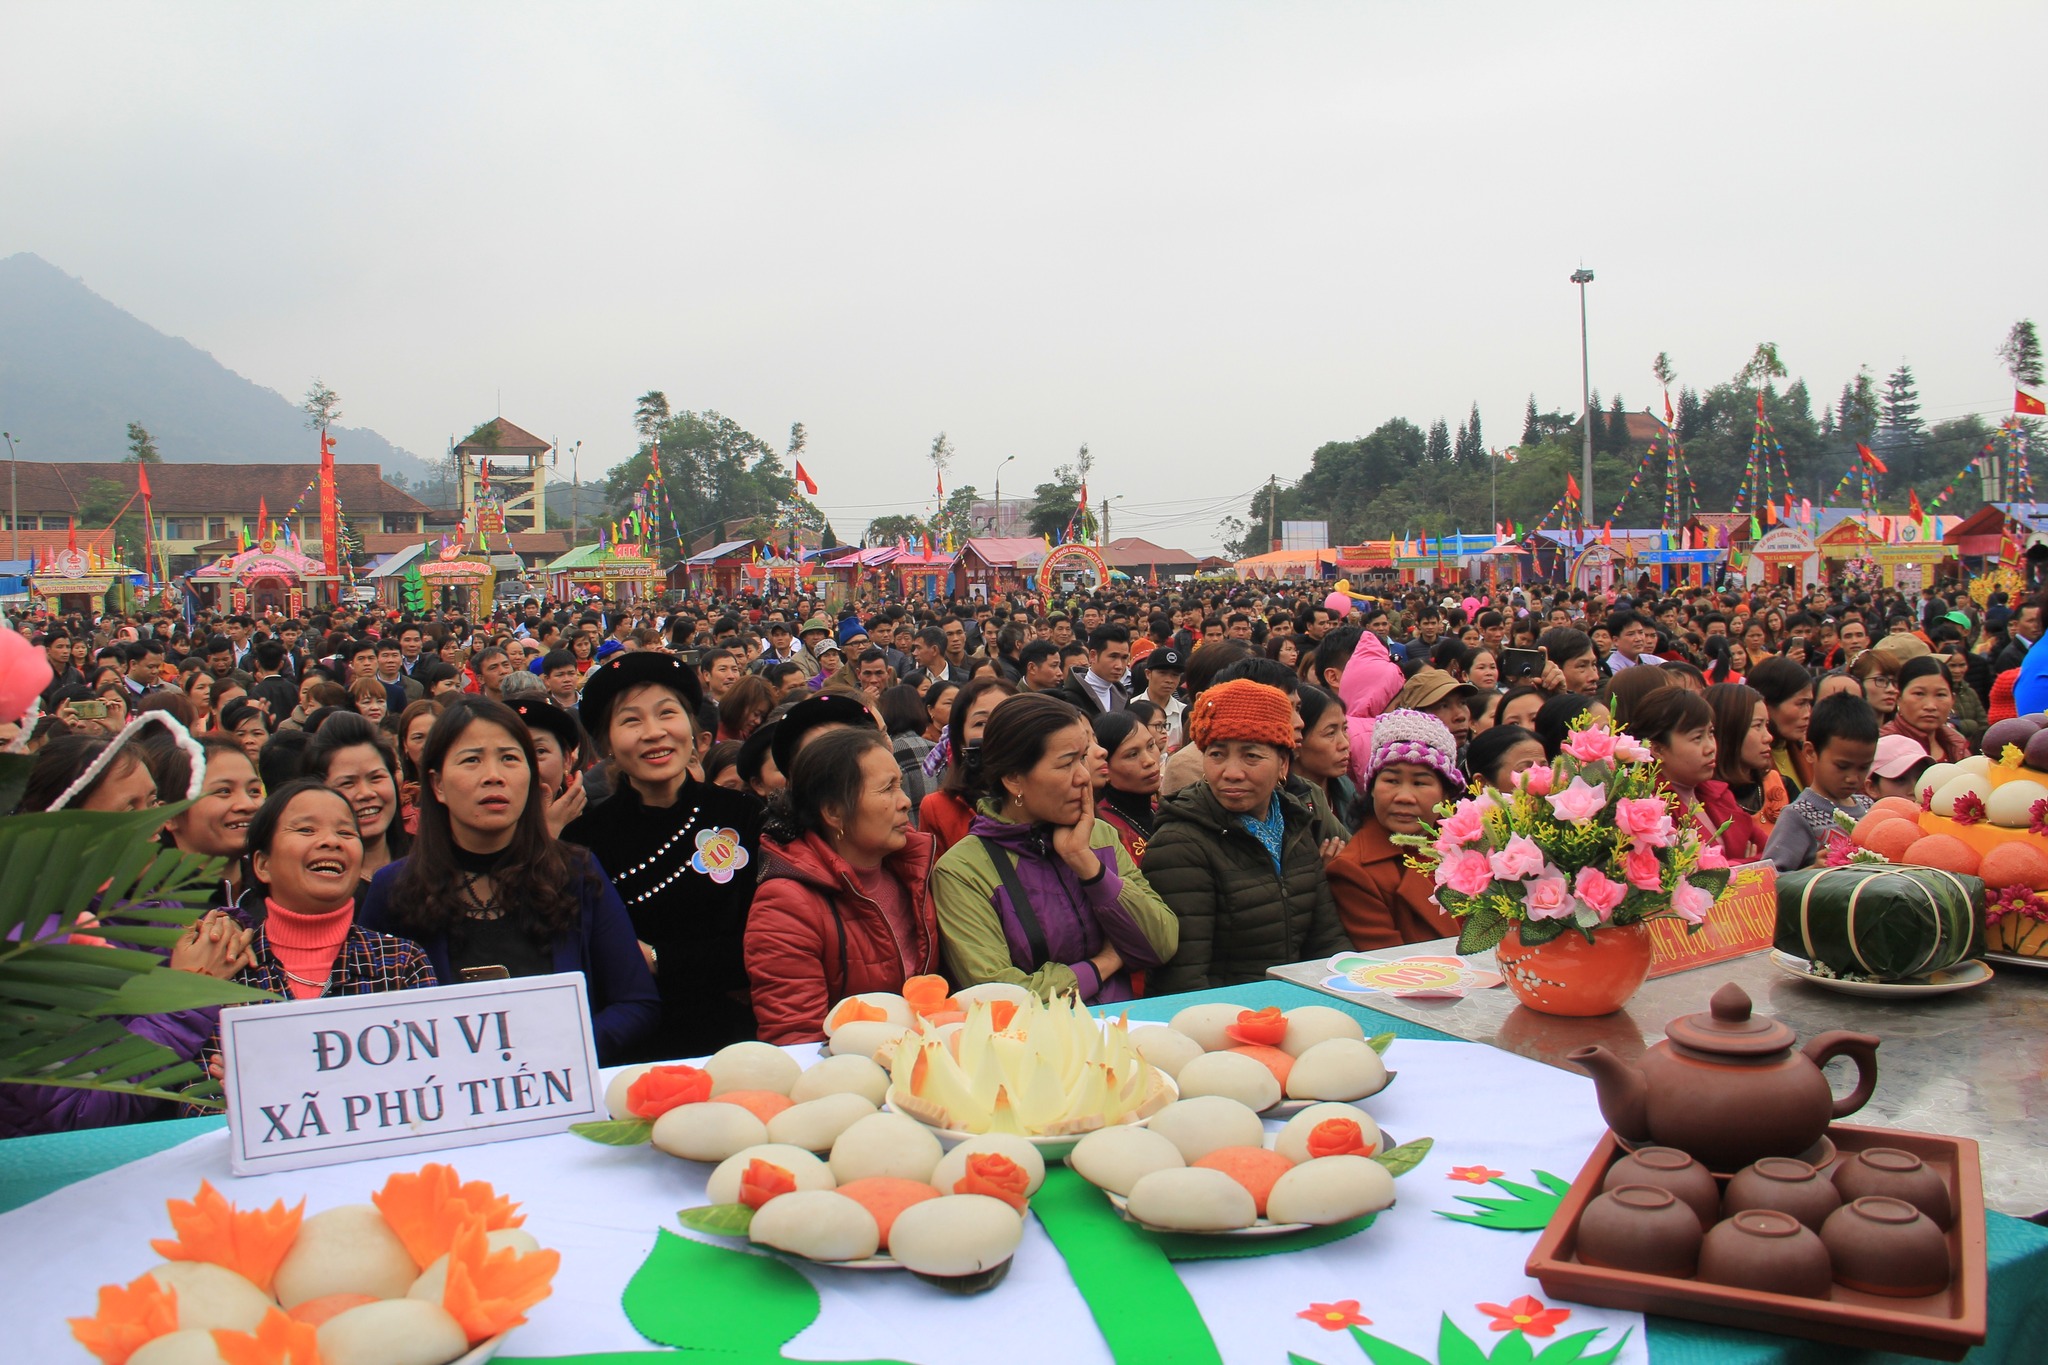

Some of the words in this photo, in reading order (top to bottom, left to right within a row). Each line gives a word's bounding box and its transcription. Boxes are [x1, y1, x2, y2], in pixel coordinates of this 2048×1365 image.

[1055, 547, 1069, 558] KHỐI
[709, 843, 731, 866] 10
[312, 1019, 440, 1072] ĐƠN
[454, 1010, 515, 1062] VỊ
[259, 1090, 332, 1143] XÃ
[342, 1074, 444, 1133] PHÚ
[458, 1062, 574, 1116] TIẾN
